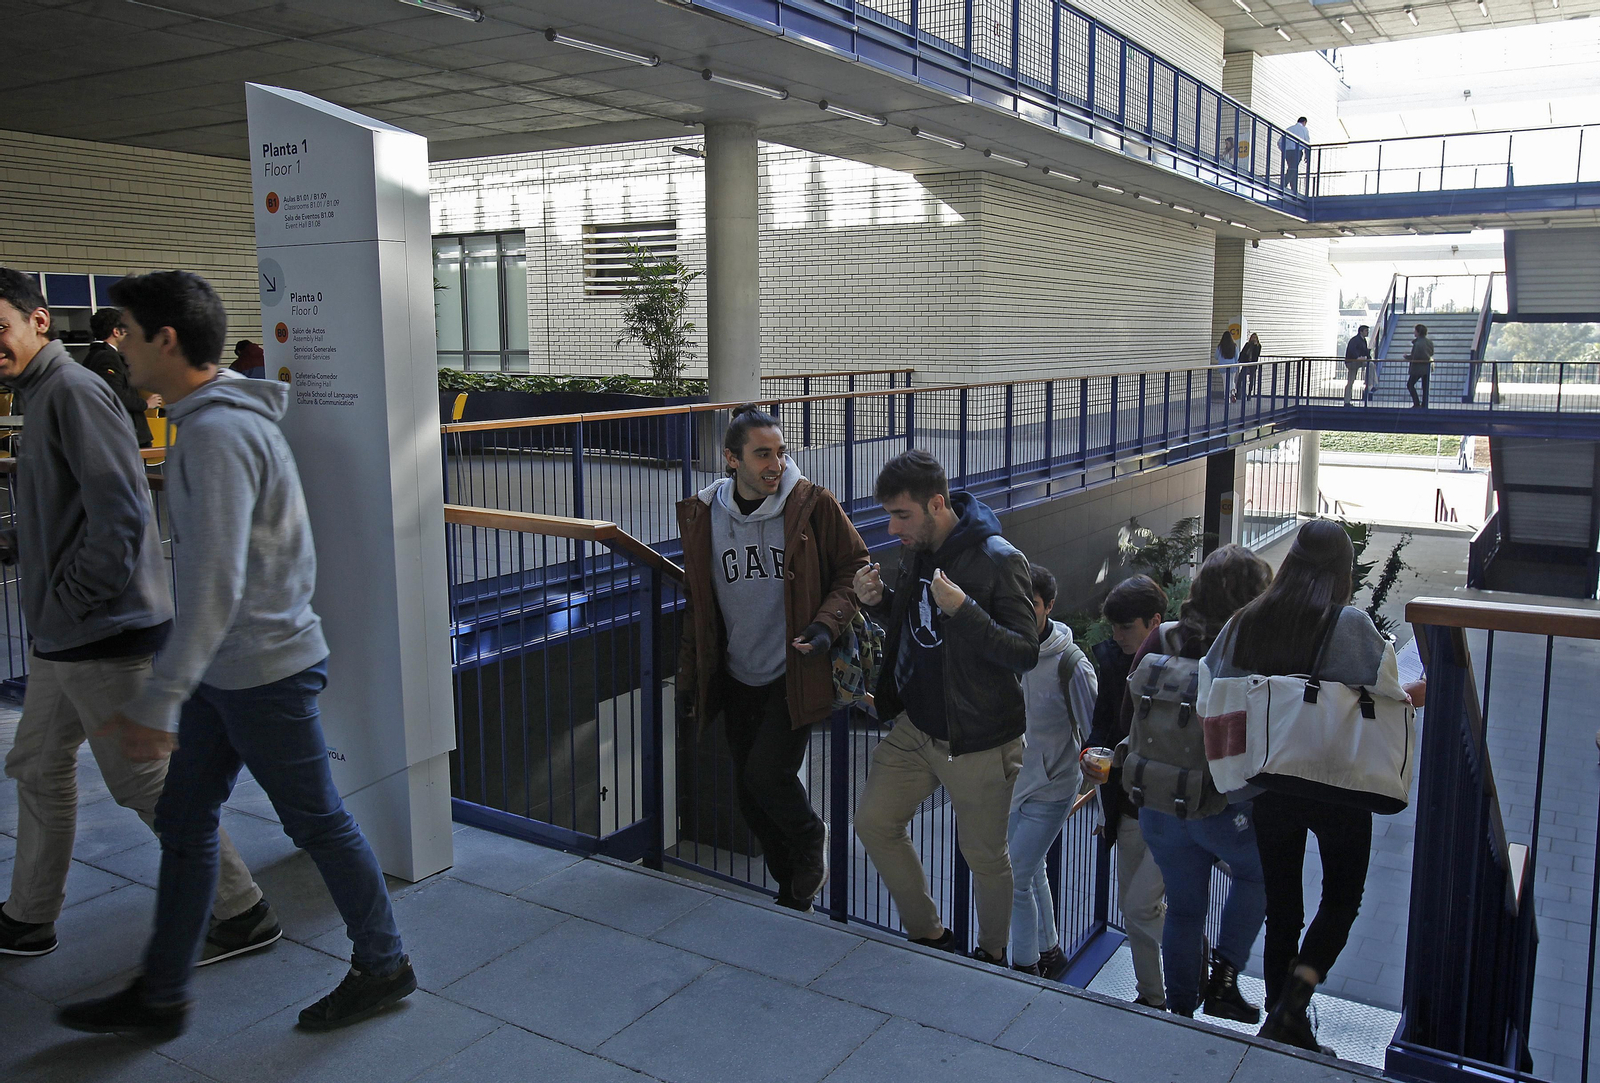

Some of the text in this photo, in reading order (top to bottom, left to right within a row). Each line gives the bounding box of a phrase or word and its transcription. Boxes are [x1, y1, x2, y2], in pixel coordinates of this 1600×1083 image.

[262, 139, 307, 158] Planta 1
[264, 160, 300, 177] Floor 1
[268, 198, 276, 207] B1
[290, 292, 322, 302] Planta 0
[292, 305, 318, 315] Floor 0
[277, 329, 286, 337] B0
[280, 373, 290, 381] C0
[297, 391, 311, 399] Loyola
[328, 751, 346, 762] YOLA
